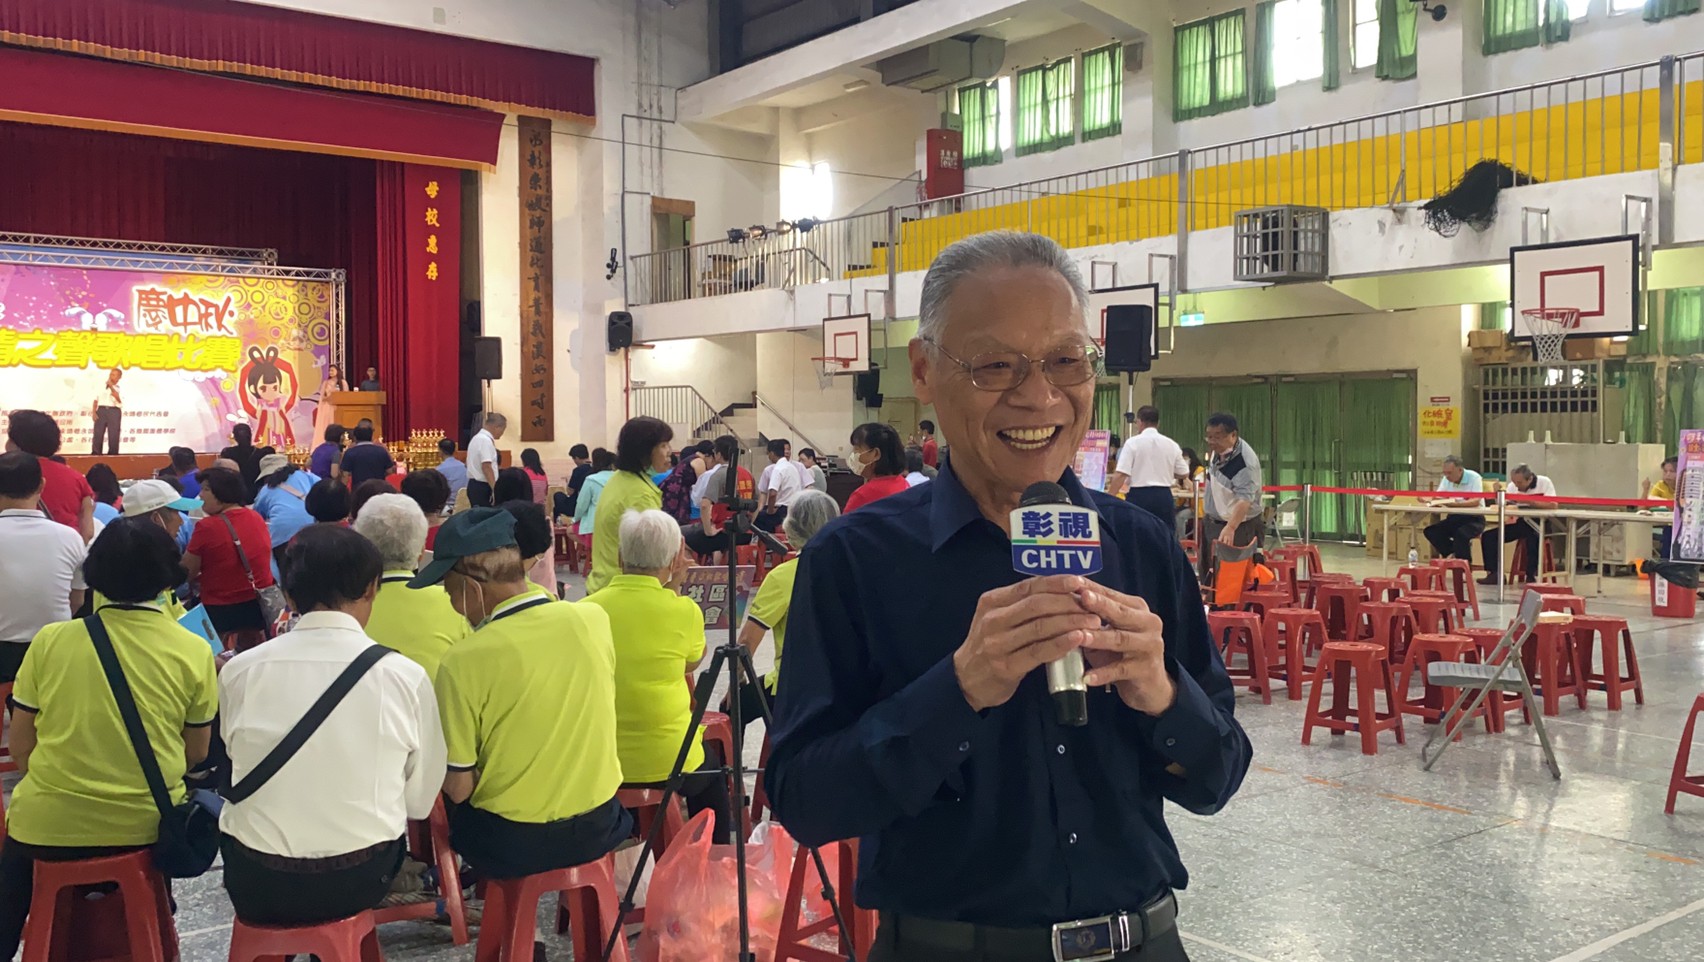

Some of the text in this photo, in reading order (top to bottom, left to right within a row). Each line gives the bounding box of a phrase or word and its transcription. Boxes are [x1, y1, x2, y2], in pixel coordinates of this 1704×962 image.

[136, 287, 235, 335] 慶中秋
[1021, 511, 1092, 539] 彰視
[1021, 550, 1093, 569] CHTV
[680, 584, 728, 603] 社區
